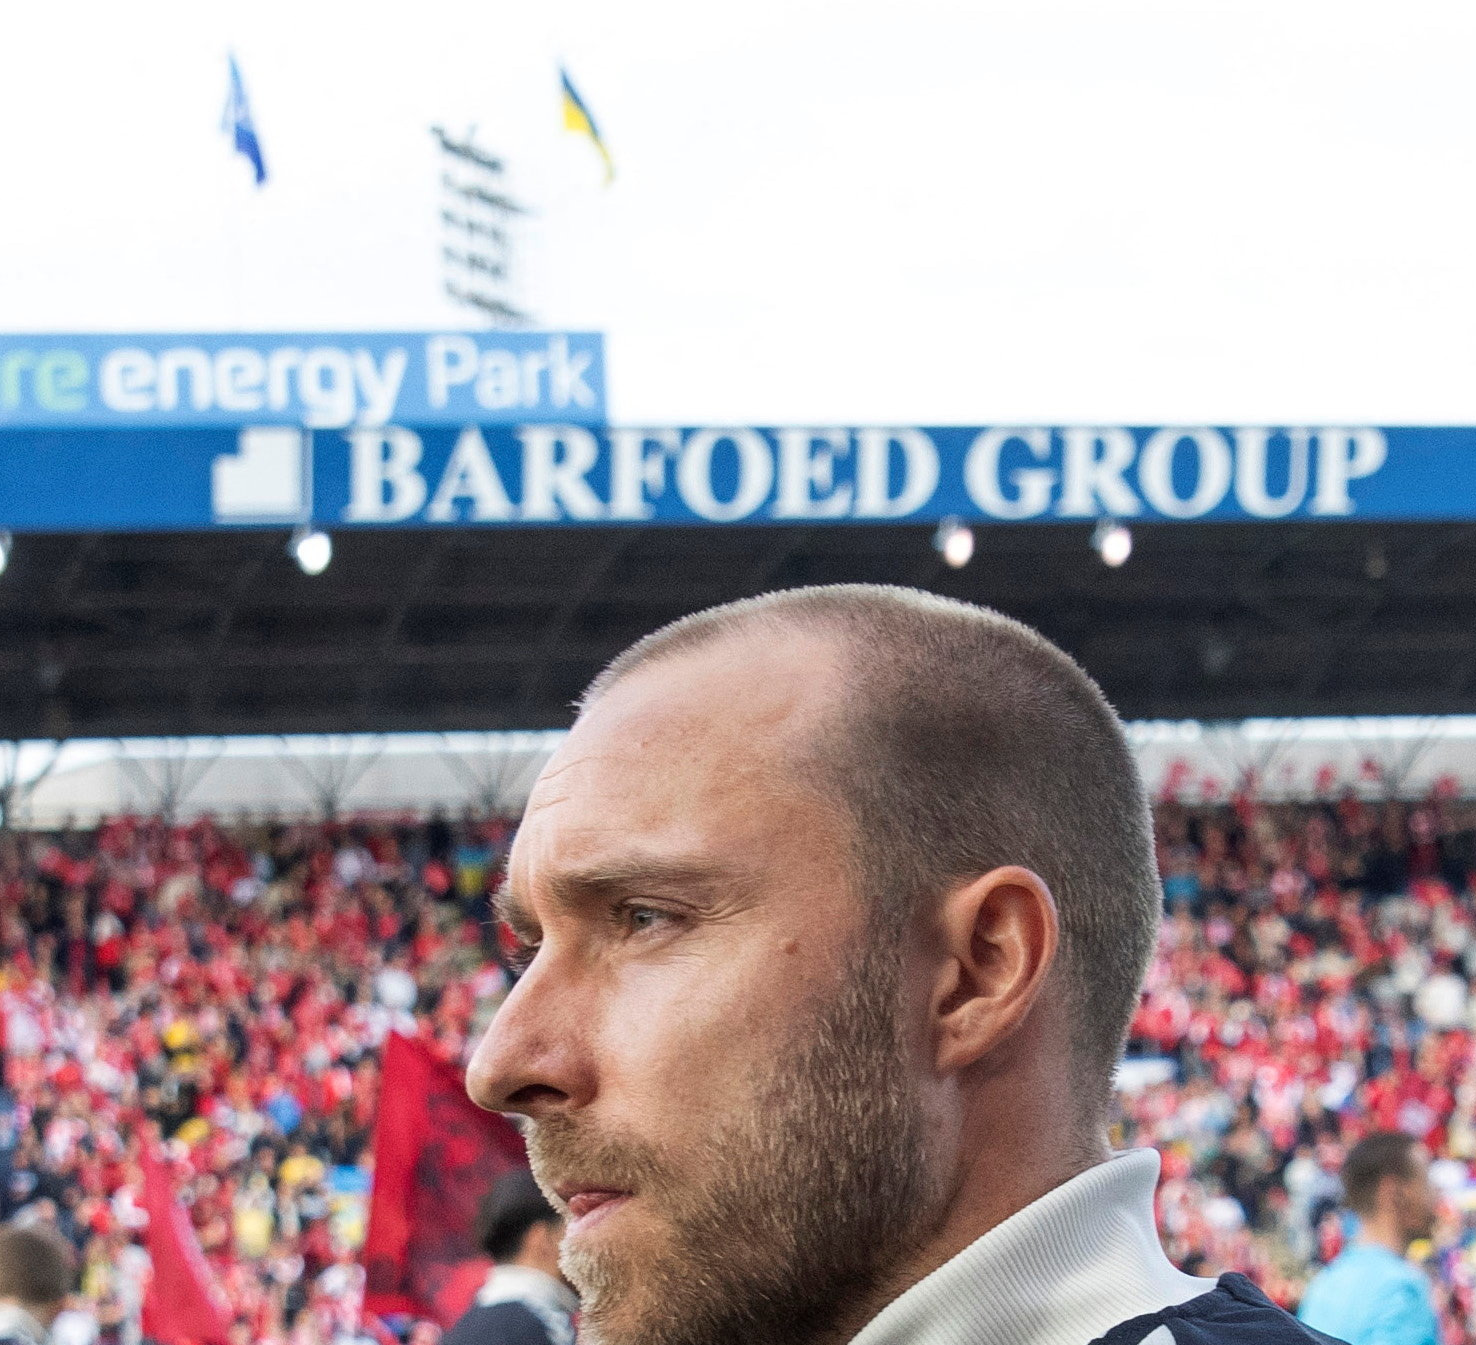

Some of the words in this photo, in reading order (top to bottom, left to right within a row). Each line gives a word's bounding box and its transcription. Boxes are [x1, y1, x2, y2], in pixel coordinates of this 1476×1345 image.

[101, 344, 406, 426] energy
[426, 333, 598, 410] Park
[346, 426, 940, 524] BARFOED
[964, 426, 1388, 521] GROUP
